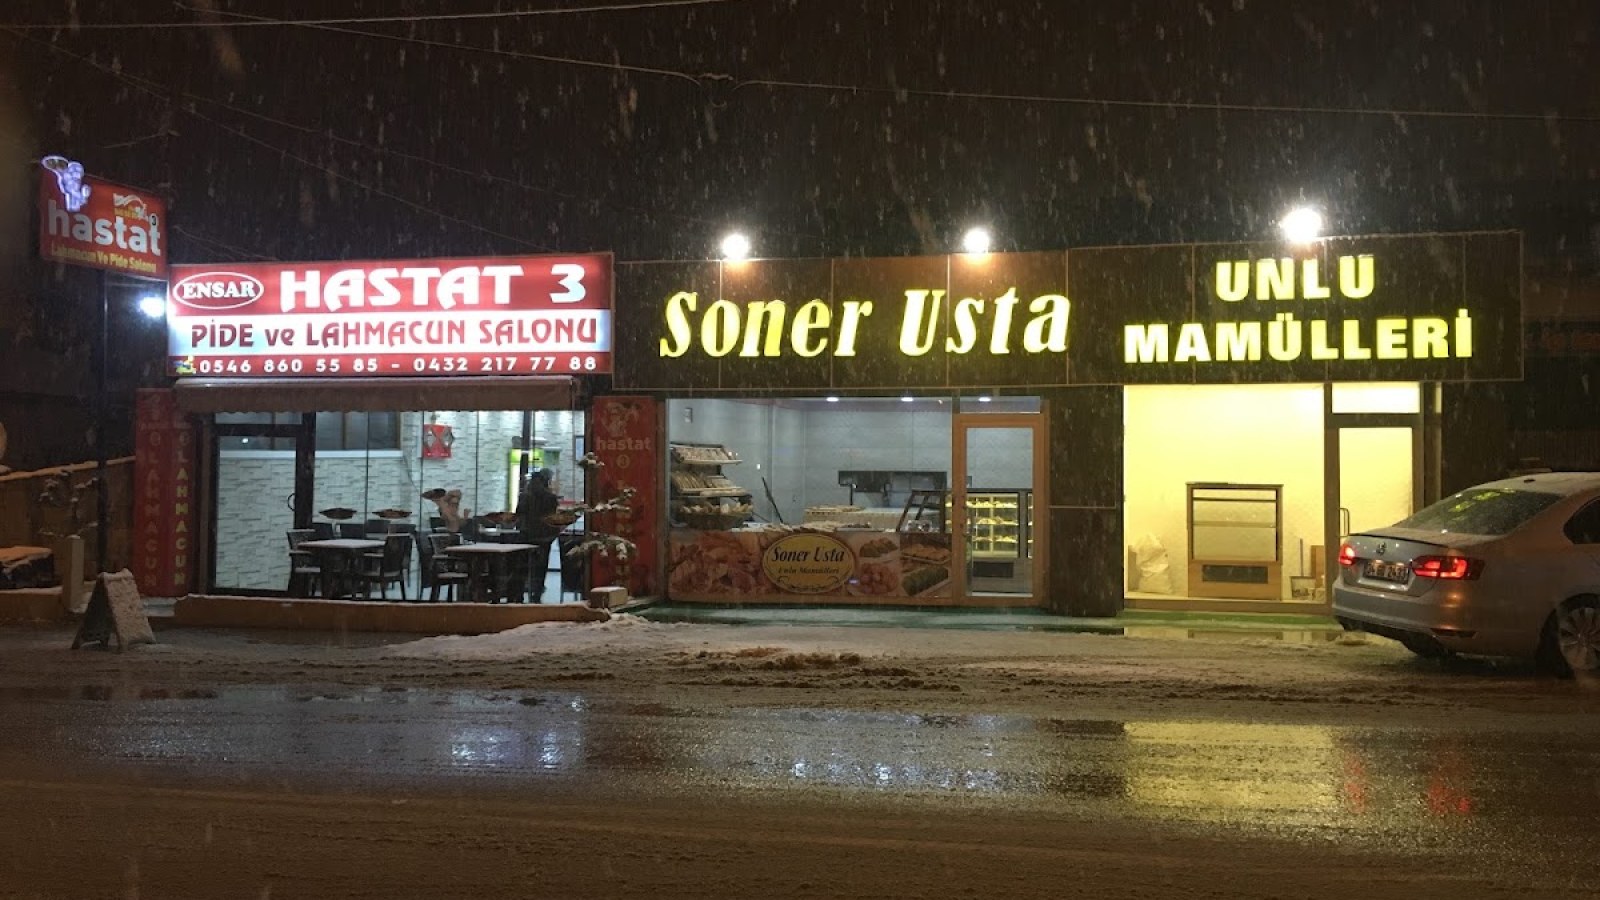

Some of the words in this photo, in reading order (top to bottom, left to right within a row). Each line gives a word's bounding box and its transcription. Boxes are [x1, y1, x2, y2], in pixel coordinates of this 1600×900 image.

[48, 200, 161, 256] hastat
[182, 281, 257, 299] ENSAR
[280, 265, 524, 312] HASTAT
[549, 263, 586, 303] 3
[1215, 254, 1375, 302] UNLU
[191, 319, 254, 348] PİDE
[264, 329, 295, 347] ve
[306, 320, 465, 348] LAHMACUN
[479, 318, 597, 346] SALONU
[659, 290, 873, 358] Soner
[898, 287, 1072, 357] Usta
[1123, 308, 1473, 364] MAMÜLLERİ
[199, 359, 252, 373] 0546
[263, 358, 303, 373] 860
[316, 358, 340, 373] 55
[353, 358, 378, 372] 85
[413, 357, 468, 371] 0432
[481, 356, 518, 371] 217
[530, 356, 556, 371] 77
[569, 356, 597, 370] 88
[596, 437, 651, 451] hastat
[771, 546, 810, 562] Soner
[813, 546, 845, 562] Usta
